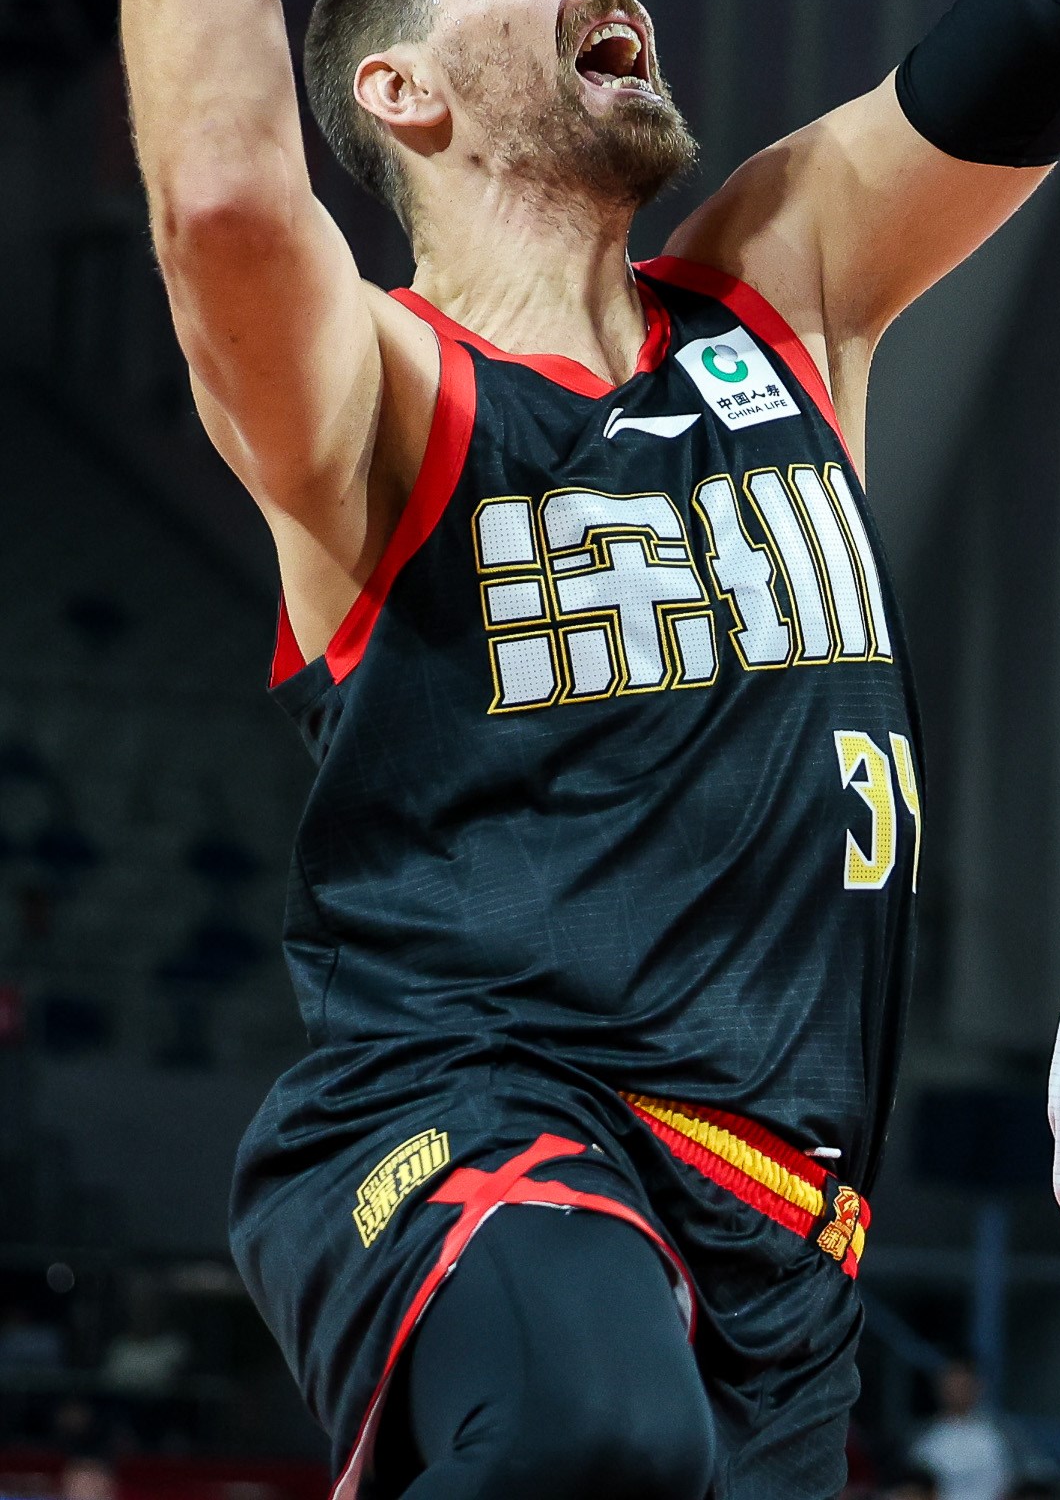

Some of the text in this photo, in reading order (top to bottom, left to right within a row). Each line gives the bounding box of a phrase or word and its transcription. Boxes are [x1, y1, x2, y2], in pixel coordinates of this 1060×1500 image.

[717, 384, 780, 410] 中国人寿
[727, 399, 788, 420] CHINA LIFE
[471, 462, 894, 714] 深圳
